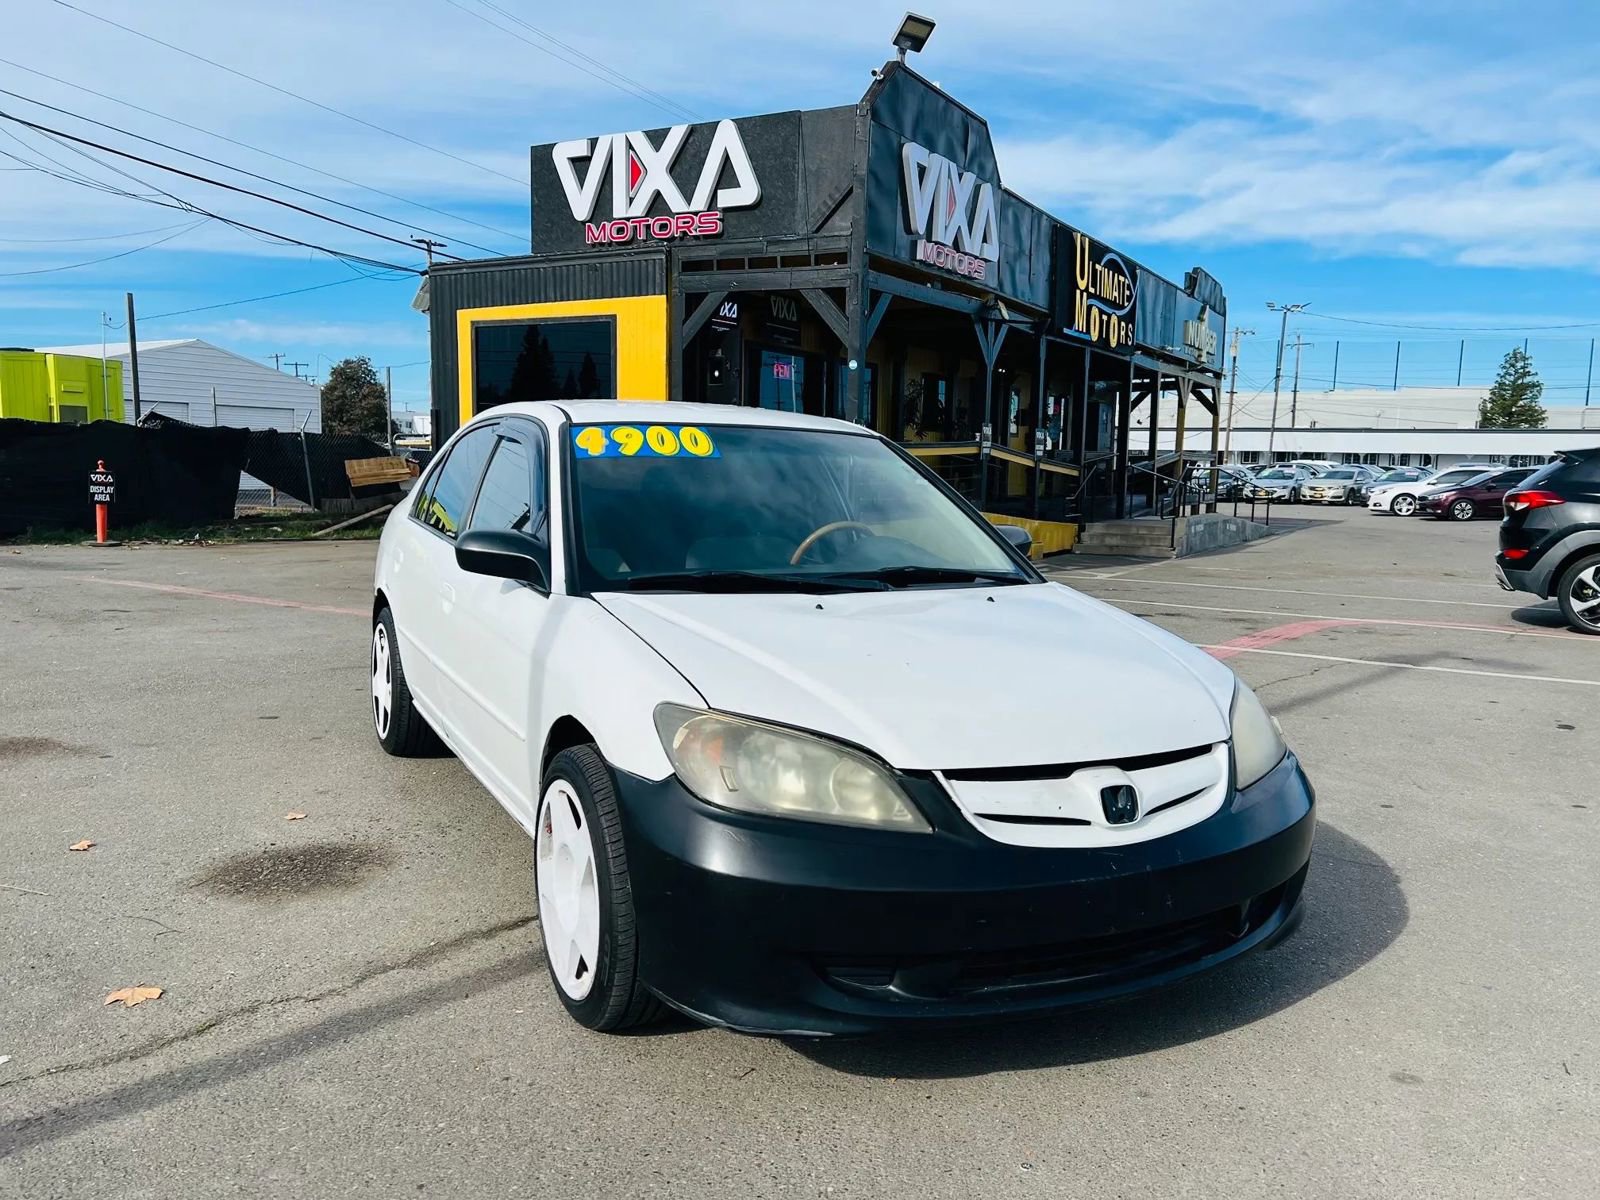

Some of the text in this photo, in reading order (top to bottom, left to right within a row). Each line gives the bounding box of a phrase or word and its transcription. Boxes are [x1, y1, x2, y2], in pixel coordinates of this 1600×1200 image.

[552, 118, 761, 222] VIXA
[902, 141, 999, 263] VIXA
[585, 211, 722, 243] MOTORS
[919, 239, 986, 280] MOTORS
[1075, 232, 1131, 306] ULTIMATE
[719, 301, 737, 318] IXA
[770, 296, 797, 321] VIXA
[1075, 289, 1133, 348] MOTORS
[575, 425, 714, 457] 4900
[90, 474, 113, 482] VIXA
[90, 485, 114, 494] DISPLAY
